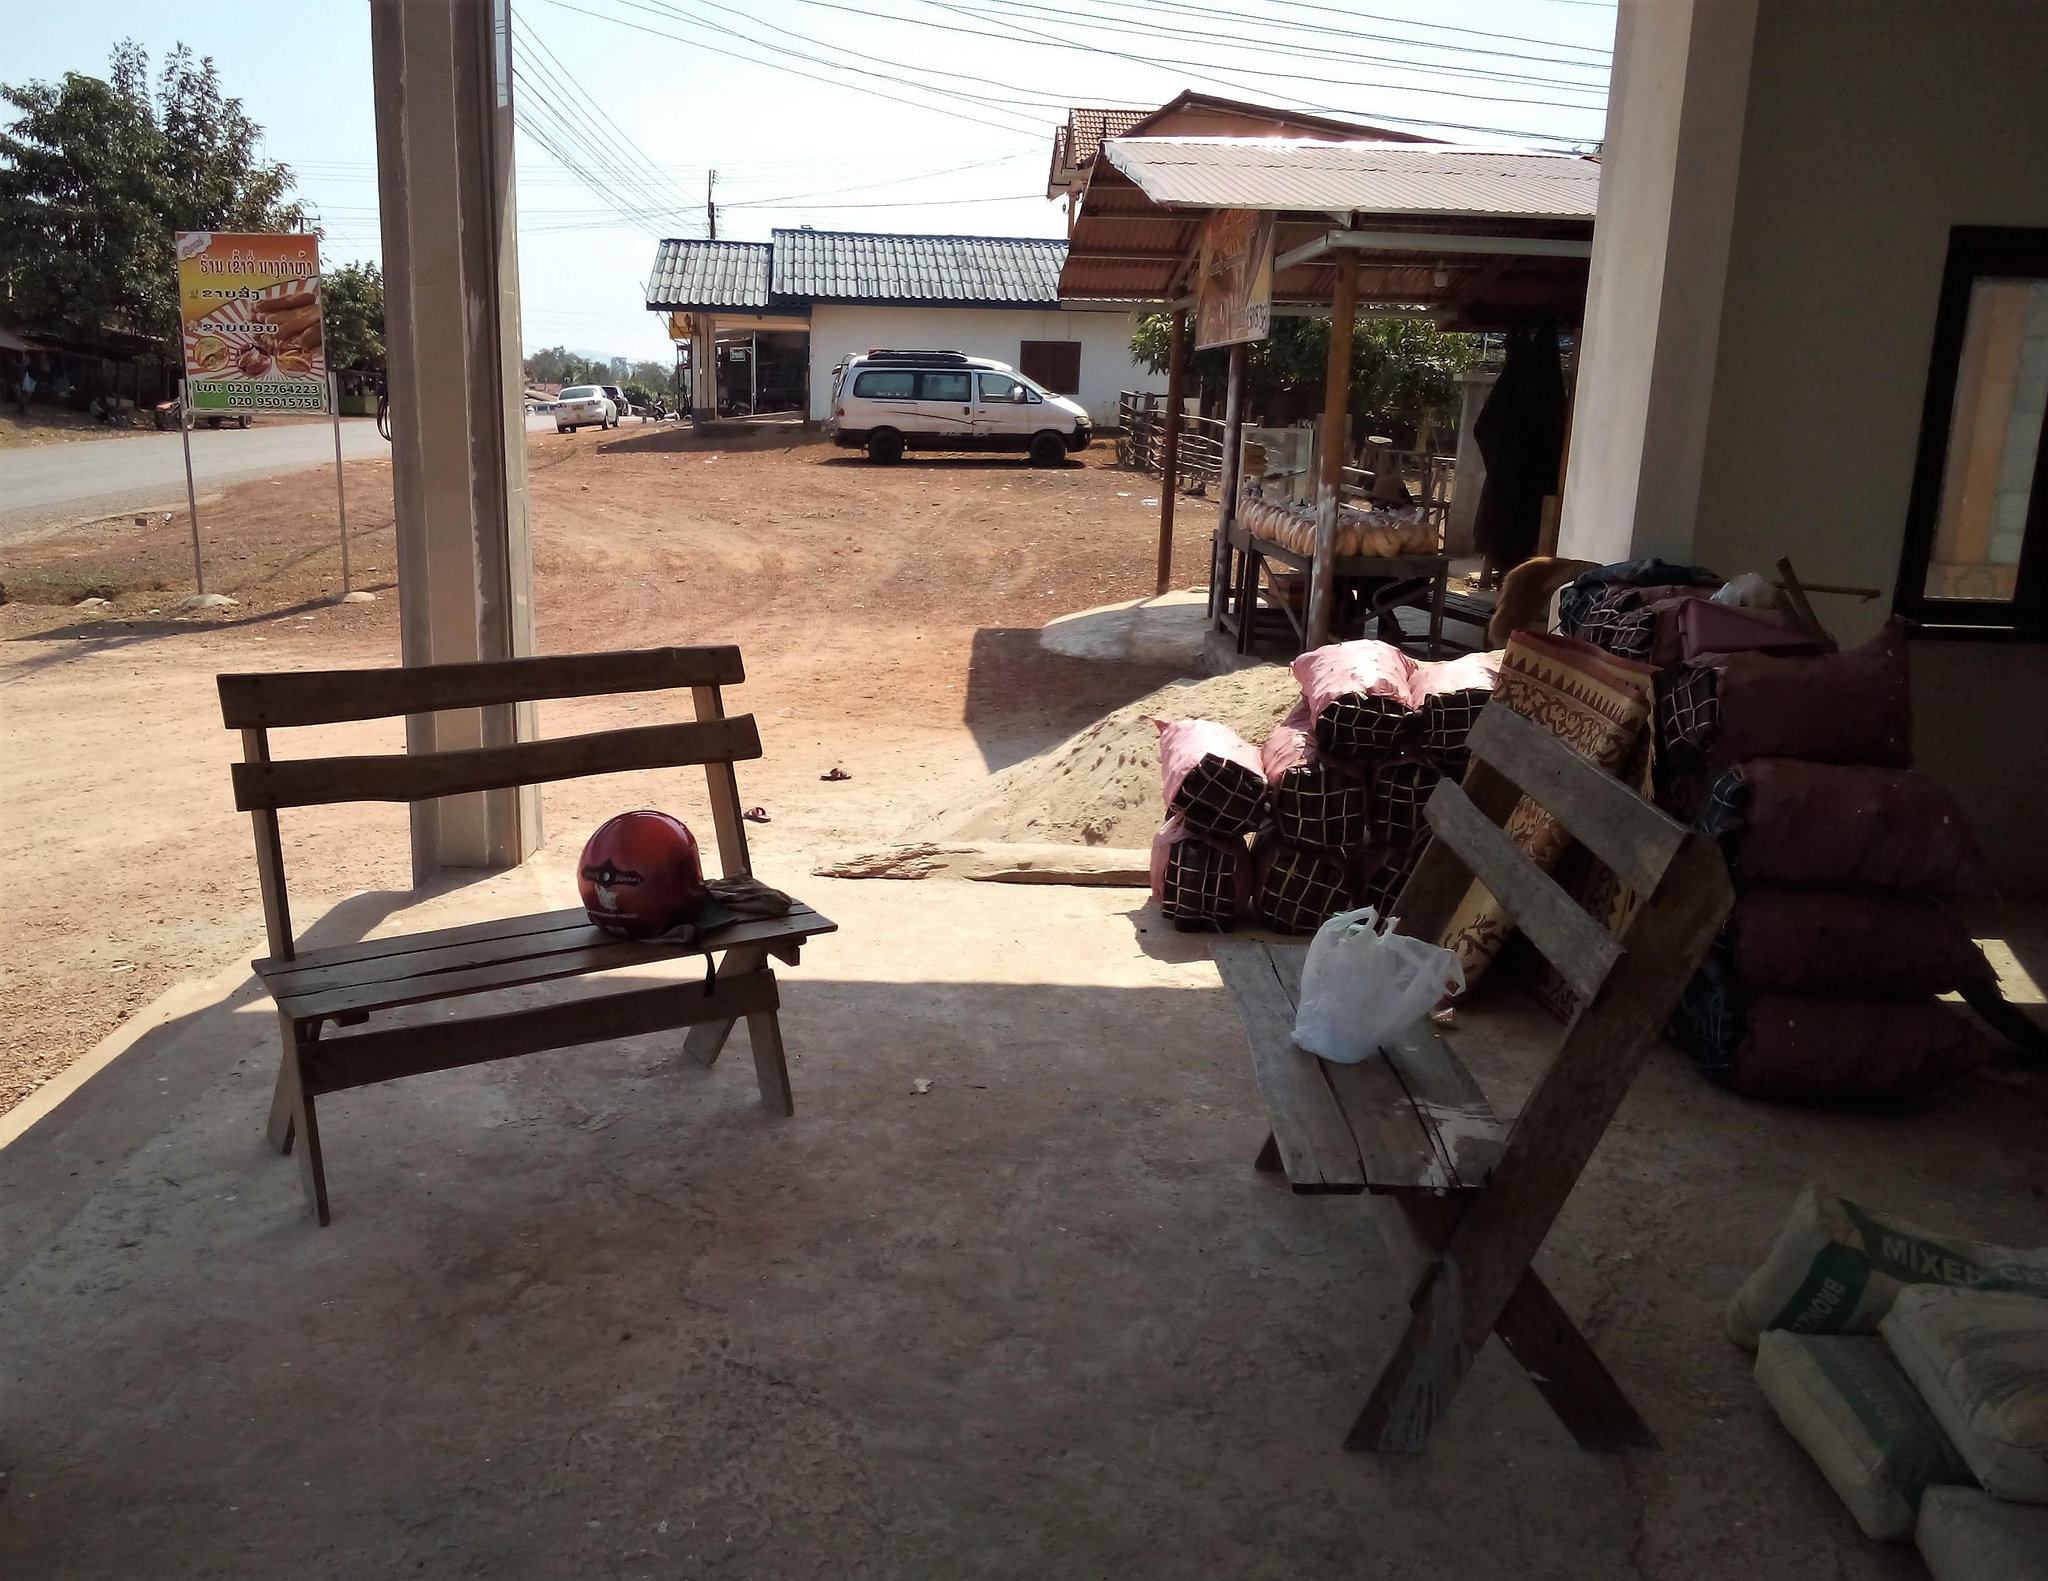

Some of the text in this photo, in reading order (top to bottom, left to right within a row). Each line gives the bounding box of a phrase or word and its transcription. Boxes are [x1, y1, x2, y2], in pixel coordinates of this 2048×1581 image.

[200, 254, 223, 275] ຮ້ານ
[227, 384, 251, 394] 020
[255, 384, 319, 395] 92764223
[228, 397, 320, 408] 020 95015758
